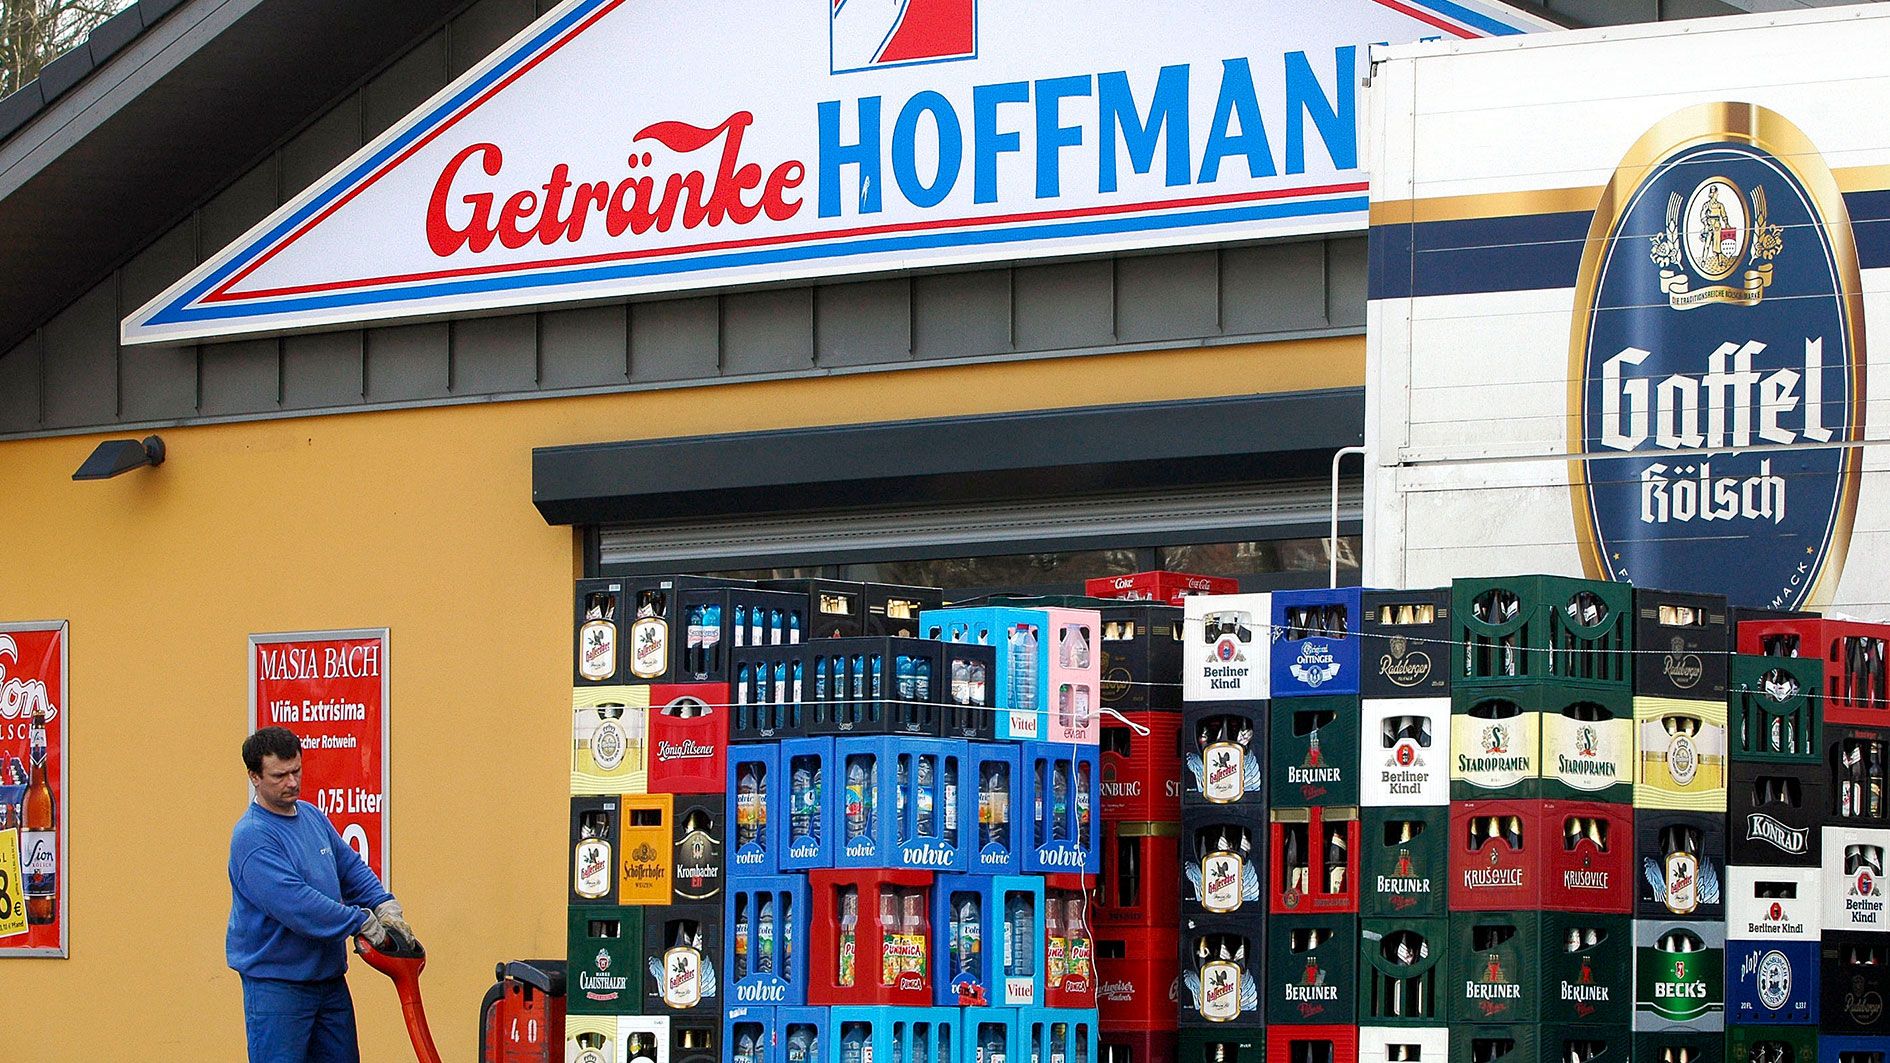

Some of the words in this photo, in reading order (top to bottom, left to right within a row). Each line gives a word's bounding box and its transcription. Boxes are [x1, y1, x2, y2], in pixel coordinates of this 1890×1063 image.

[426, 110, 804, 257] Getränke
[817, 43, 1388, 219] HOFFMAN
[1680, 290, 1724, 304] TRADITIONSREICHE
[1601, 335, 1833, 458] Gaffel
[1640, 458, 1786, 525] Kölsch
[1767, 562, 1808, 610] MACK
[260, 649, 319, 681] MASIA
[323, 646, 379, 678] BACH
[1203, 666, 1249, 678] Berliner
[1210, 678, 1241, 690] Kindl
[271, 701, 299, 723] Viña
[302, 698, 365, 722] Extrísima
[1011, 717, 1037, 731] Vittel
[321, 734, 356, 749] Rotwein
[682, 739, 714, 756] Pilsener
[1458, 753, 1530, 773] STAROPRAMEN
[1558, 753, 1616, 776] STAROPRAMEN
[1288, 766, 1341, 784] BERLINER
[1381, 771, 1429, 783] Berliner
[1100, 780, 1141, 796] RNBURG
[1389, 783, 1421, 794] Kindl
[317, 789, 343, 816] 0,75
[347, 788, 383, 813] Liter
[1751, 816, 1803, 851] KONRAD
[736, 850, 765, 864] volvic
[790, 845, 819, 858] volvic
[846, 845, 875, 857] volvic
[903, 842, 954, 866] volvic
[980, 850, 1010, 865] volvic
[1039, 845, 1087, 867] volvic
[624, 861, 665, 880] Schöfferhofer
[677, 864, 719, 879] Krombacher
[1464, 866, 1523, 889] KRUŠOVICE
[1564, 868, 1609, 889] KRUŠOVICE
[1377, 875, 1430, 894] BERLINER
[1846, 898, 1883, 911] Berliner
[1851, 911, 1876, 923] Kindl
[1748, 923, 1780, 933] Berliner
[1782, 923, 1803, 933] Kindl
[579, 971, 626, 990] CLAUSTHALER
[737, 978, 786, 1001] volvic
[1655, 980, 1706, 998] BECK'S
[1007, 984, 1033, 997] Vittel
[1285, 983, 1338, 1002] BERLINER
[1466, 981, 1520, 1000] BERLINER
[1561, 981, 1609, 1002] BERLINER
